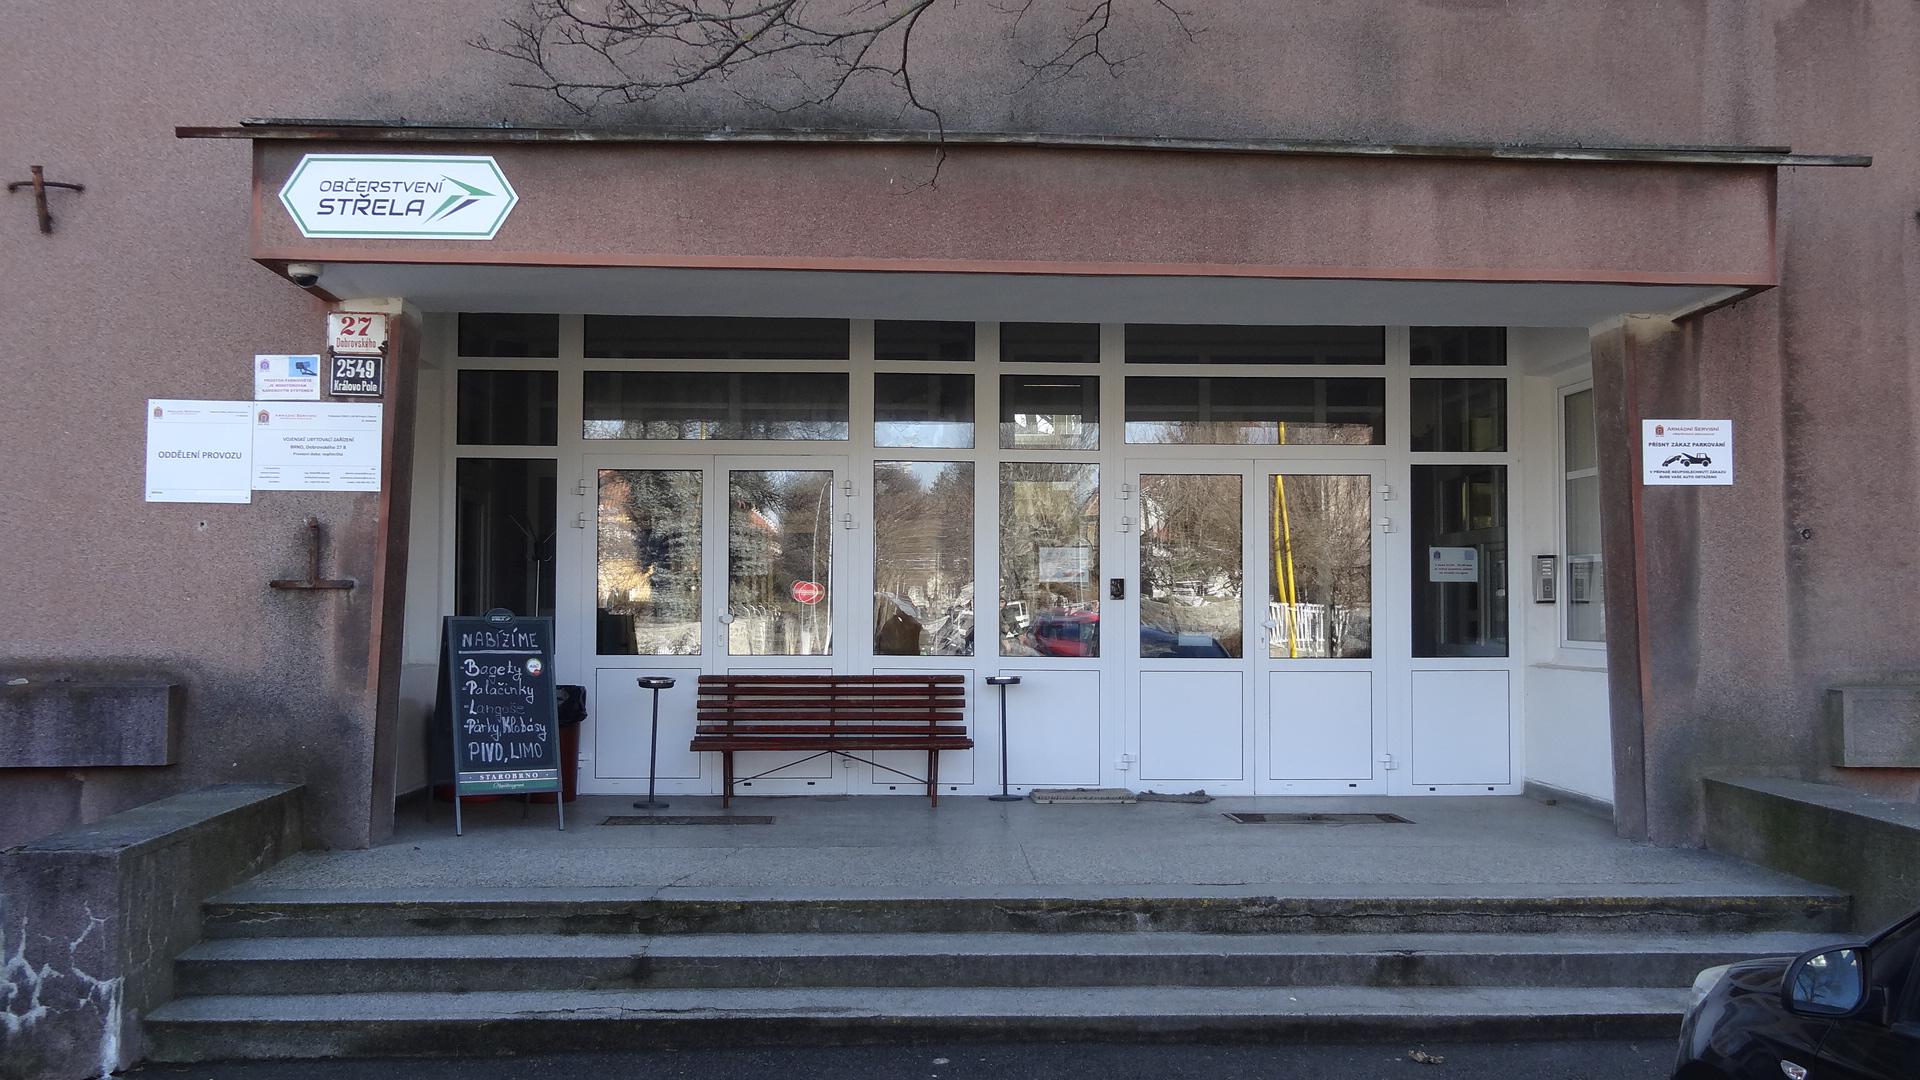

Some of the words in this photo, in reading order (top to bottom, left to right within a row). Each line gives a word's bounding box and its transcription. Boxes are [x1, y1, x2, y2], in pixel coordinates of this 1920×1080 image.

[319, 177, 446, 193] OBČERSTVENÍ
[317, 193, 425, 216] STŘELA
[340, 316, 372, 336] 27
[336, 337, 377, 348] Dobrovského
[336, 360, 375, 378] 2549
[334, 380, 361, 392] Královo
[362, 380, 378, 392] Pole
[158, 450, 200, 458] ODDĚLENÍ
[202, 451, 242, 460] PROVOZU
[462, 627, 538, 648] NABÍZÍME
[502, 716, 547, 741] Klobásy
[510, 742, 542, 759] LIMO
[480, 772, 538, 780] STAROBRNO
